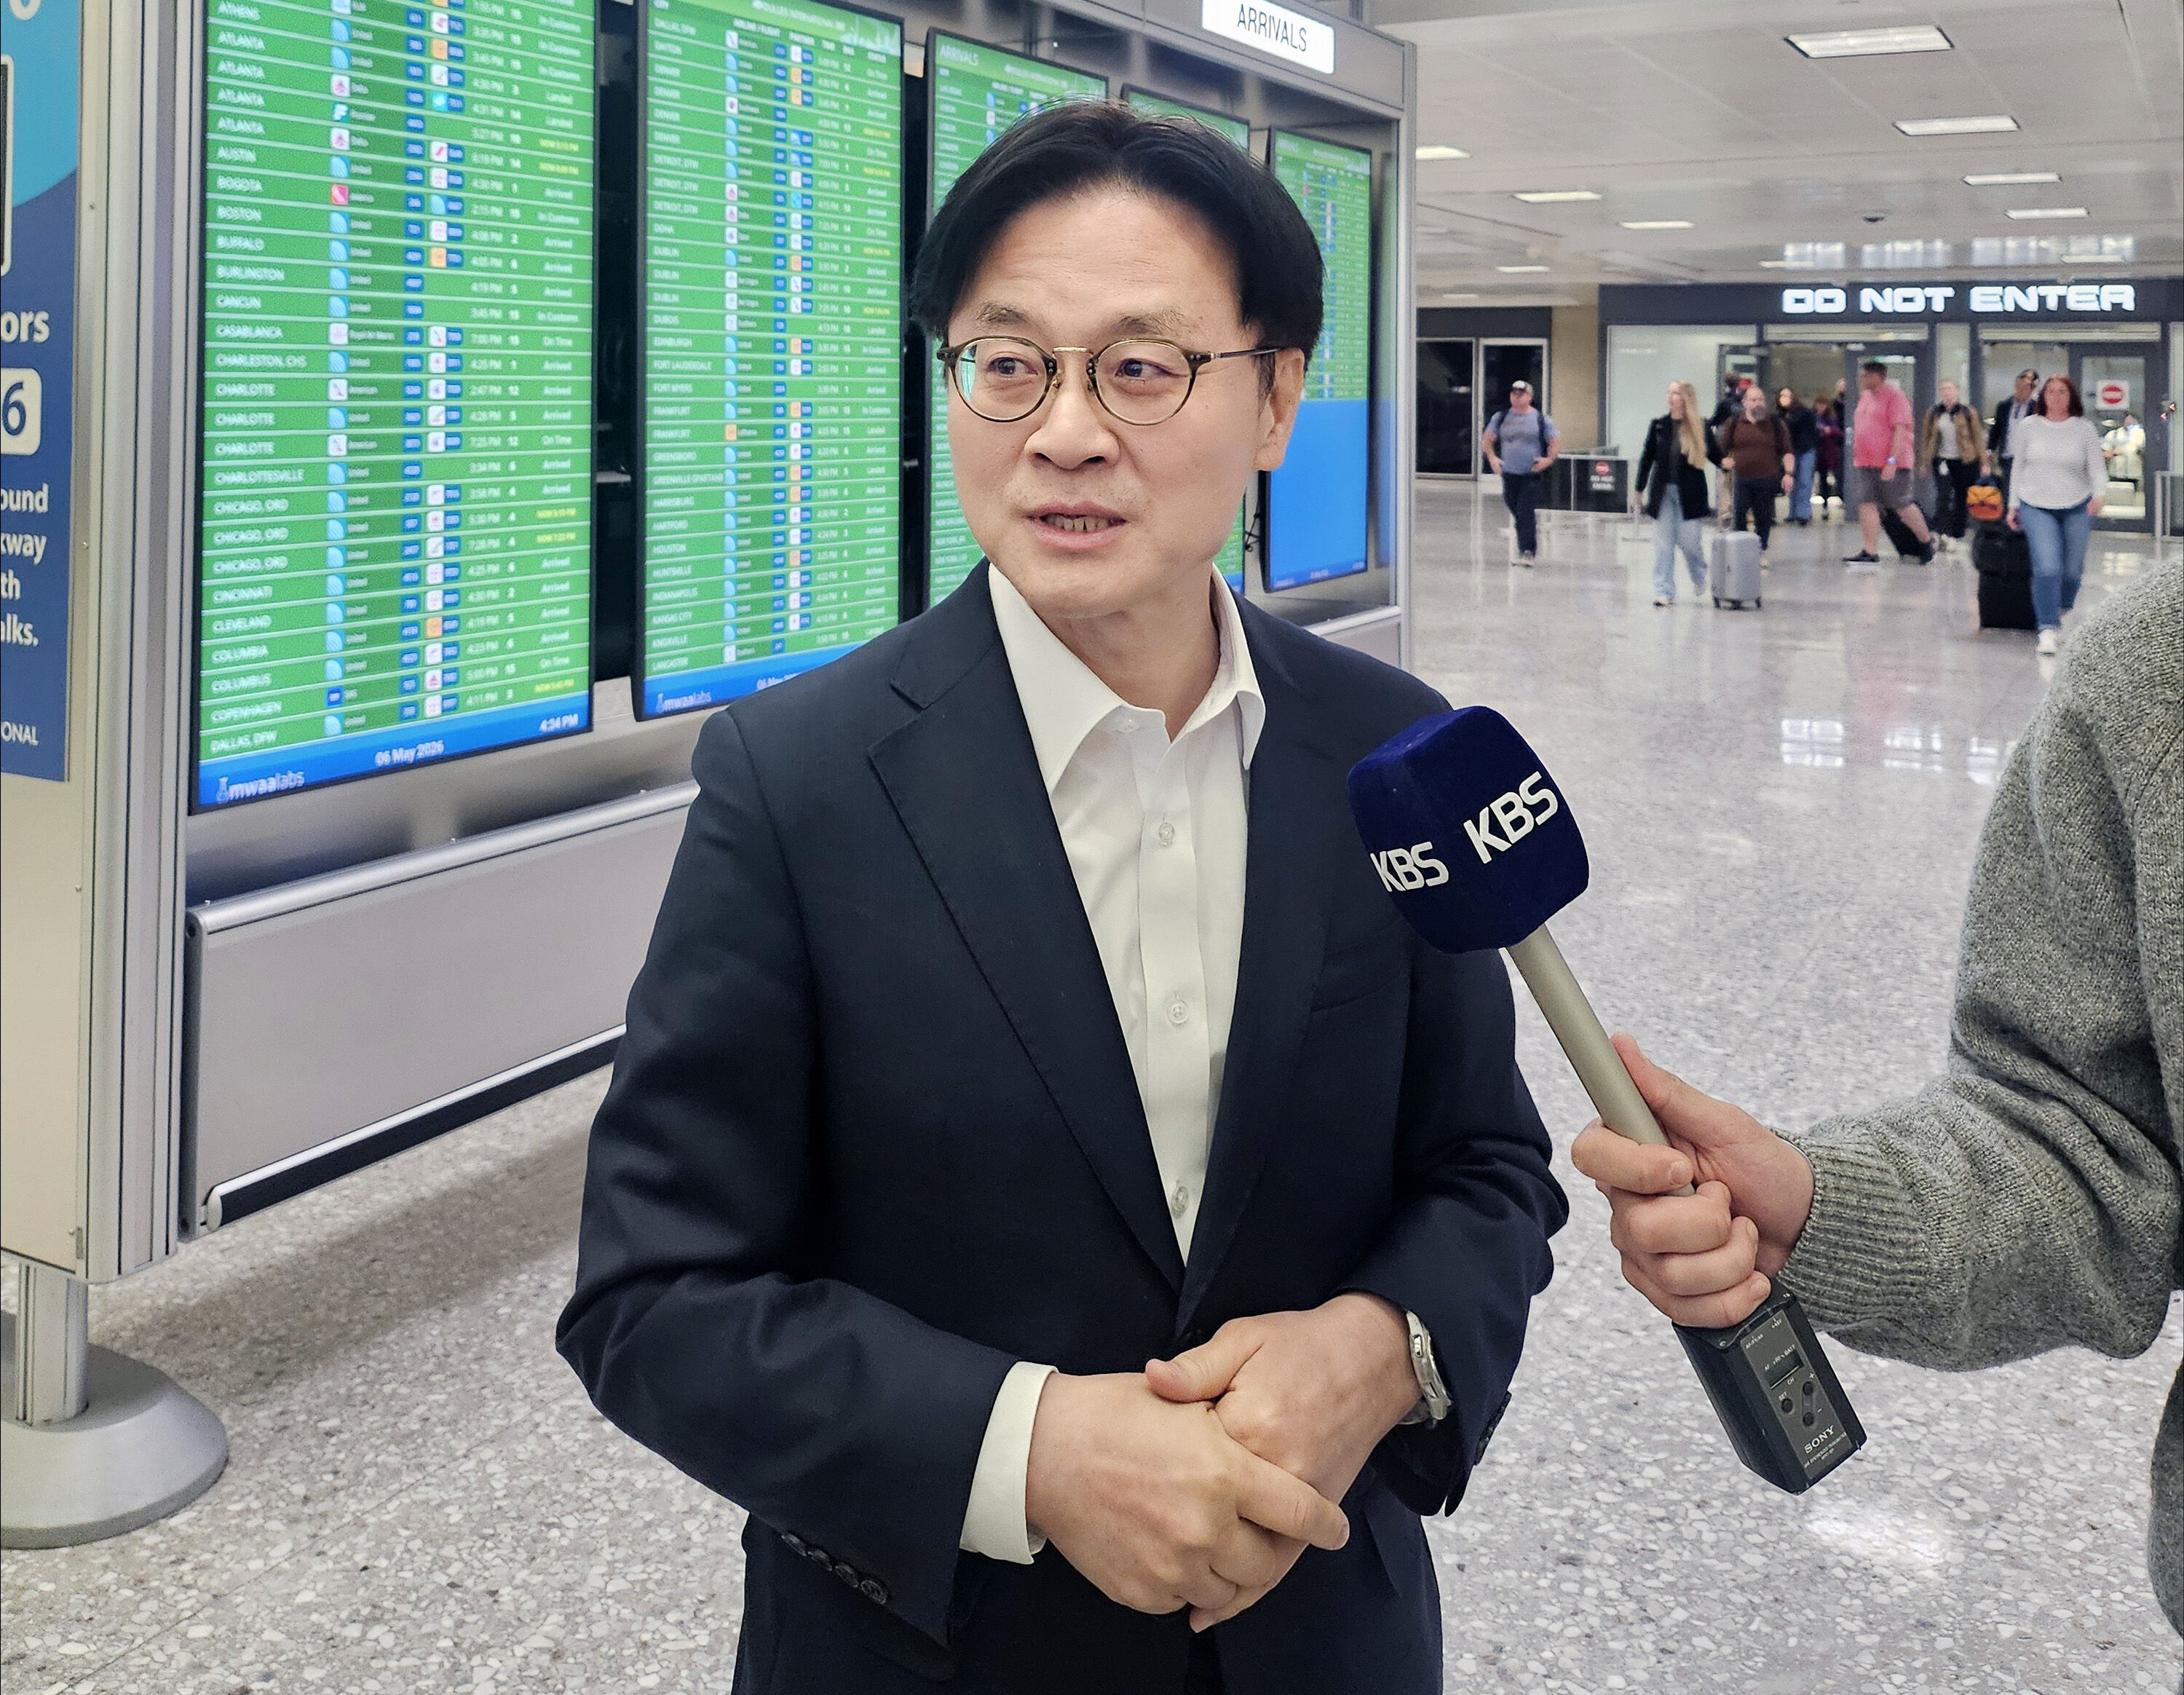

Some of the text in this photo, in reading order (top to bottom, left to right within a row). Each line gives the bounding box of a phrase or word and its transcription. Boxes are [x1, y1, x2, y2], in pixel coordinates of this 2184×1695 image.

[1238, 4, 1307, 52] ARRIVALS
[940, 44, 978, 66] ARRIVALS
[1782, 285, 2135, 314] DO NOT ENTER
[539, 713, 579, 732] 4:34 PM
[375, 739, 444, 766] 06 May 2026
[1463, 770, 1559, 864] KBS
[1370, 841, 1449, 893] KBS
[1804, 1425, 1835, 1454] SONY
